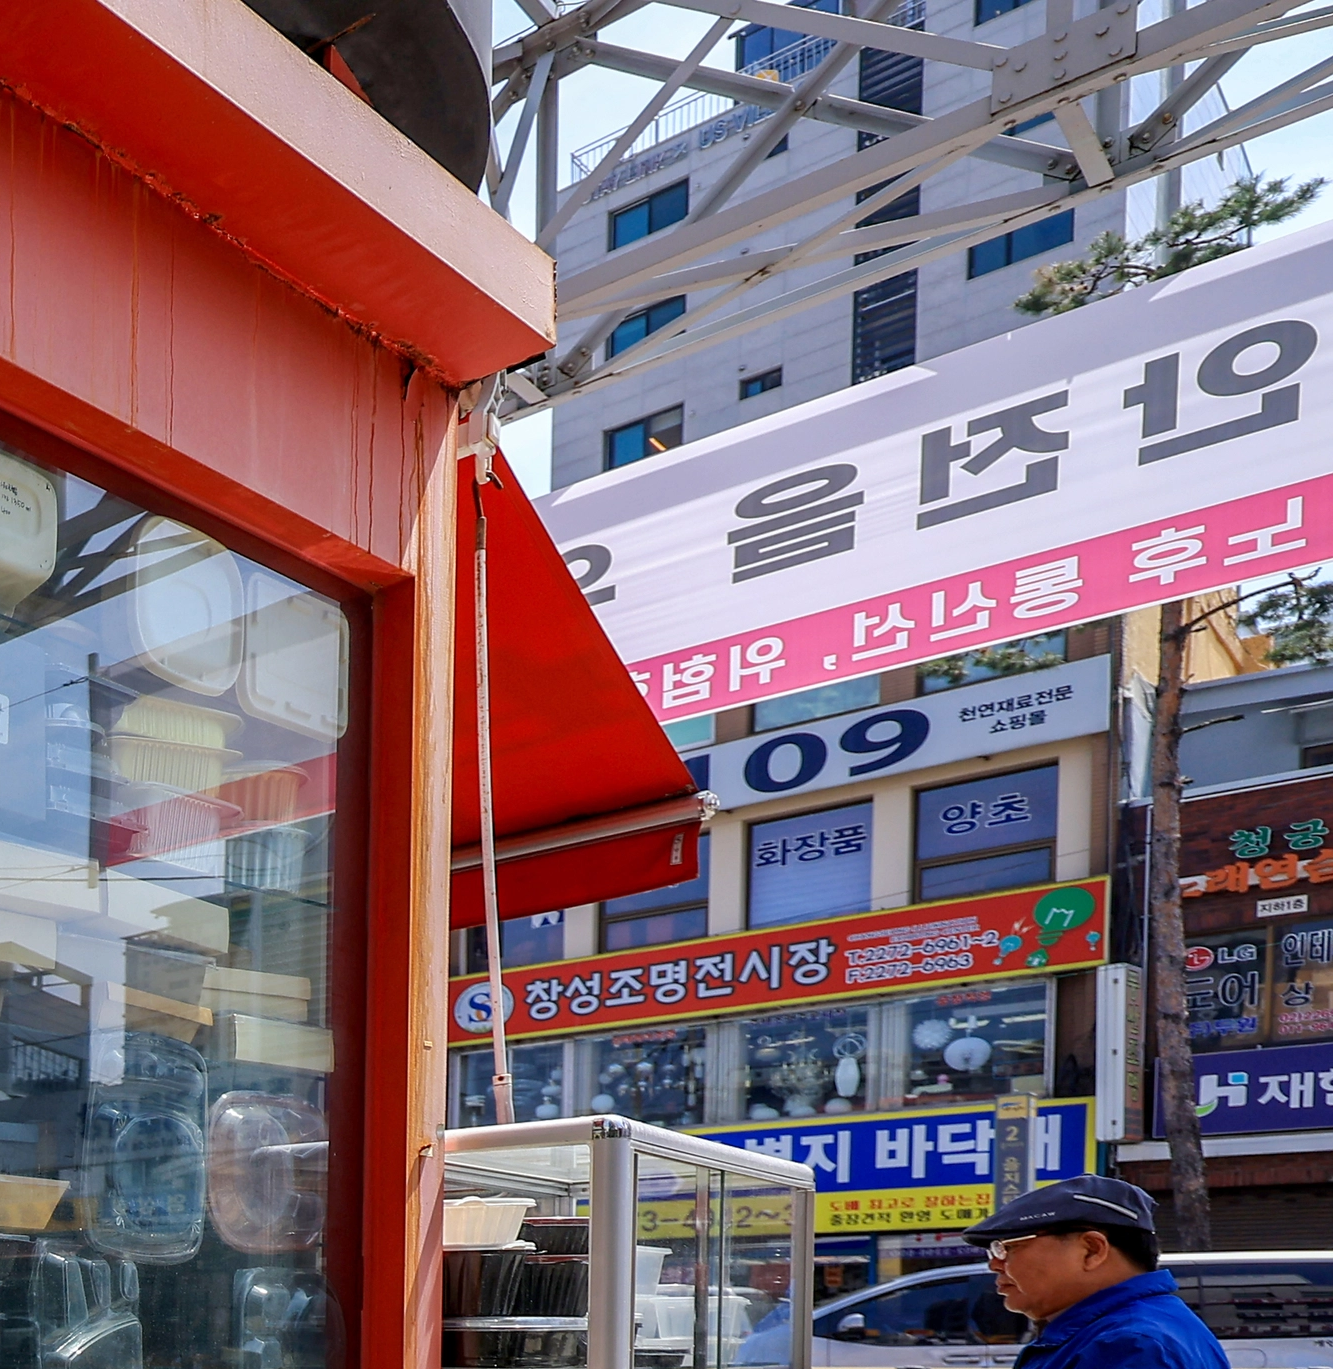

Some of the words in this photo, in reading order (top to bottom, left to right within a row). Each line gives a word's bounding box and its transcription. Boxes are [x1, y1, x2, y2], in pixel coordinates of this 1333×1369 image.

[958, 683, 1075, 724] 천연재료전문
[988, 709, 1049, 735] 쇼핑몰
[940, 792, 1033, 836] 양초
[755, 823, 868, 868] 화장품
[1258, 898, 1306, 914] 지하1층
[845, 930, 1000, 966] T.2272-6961~2
[1217, 944, 1258, 964] LG
[524, 937, 836, 1022] 창성조명전시장
[845, 953, 973, 983] F.2272-6963
[1281, 980, 1314, 1007] 상
[1005, 1125, 1020, 1142] 2
[1019, 1211, 1057, 1222] MACAW
